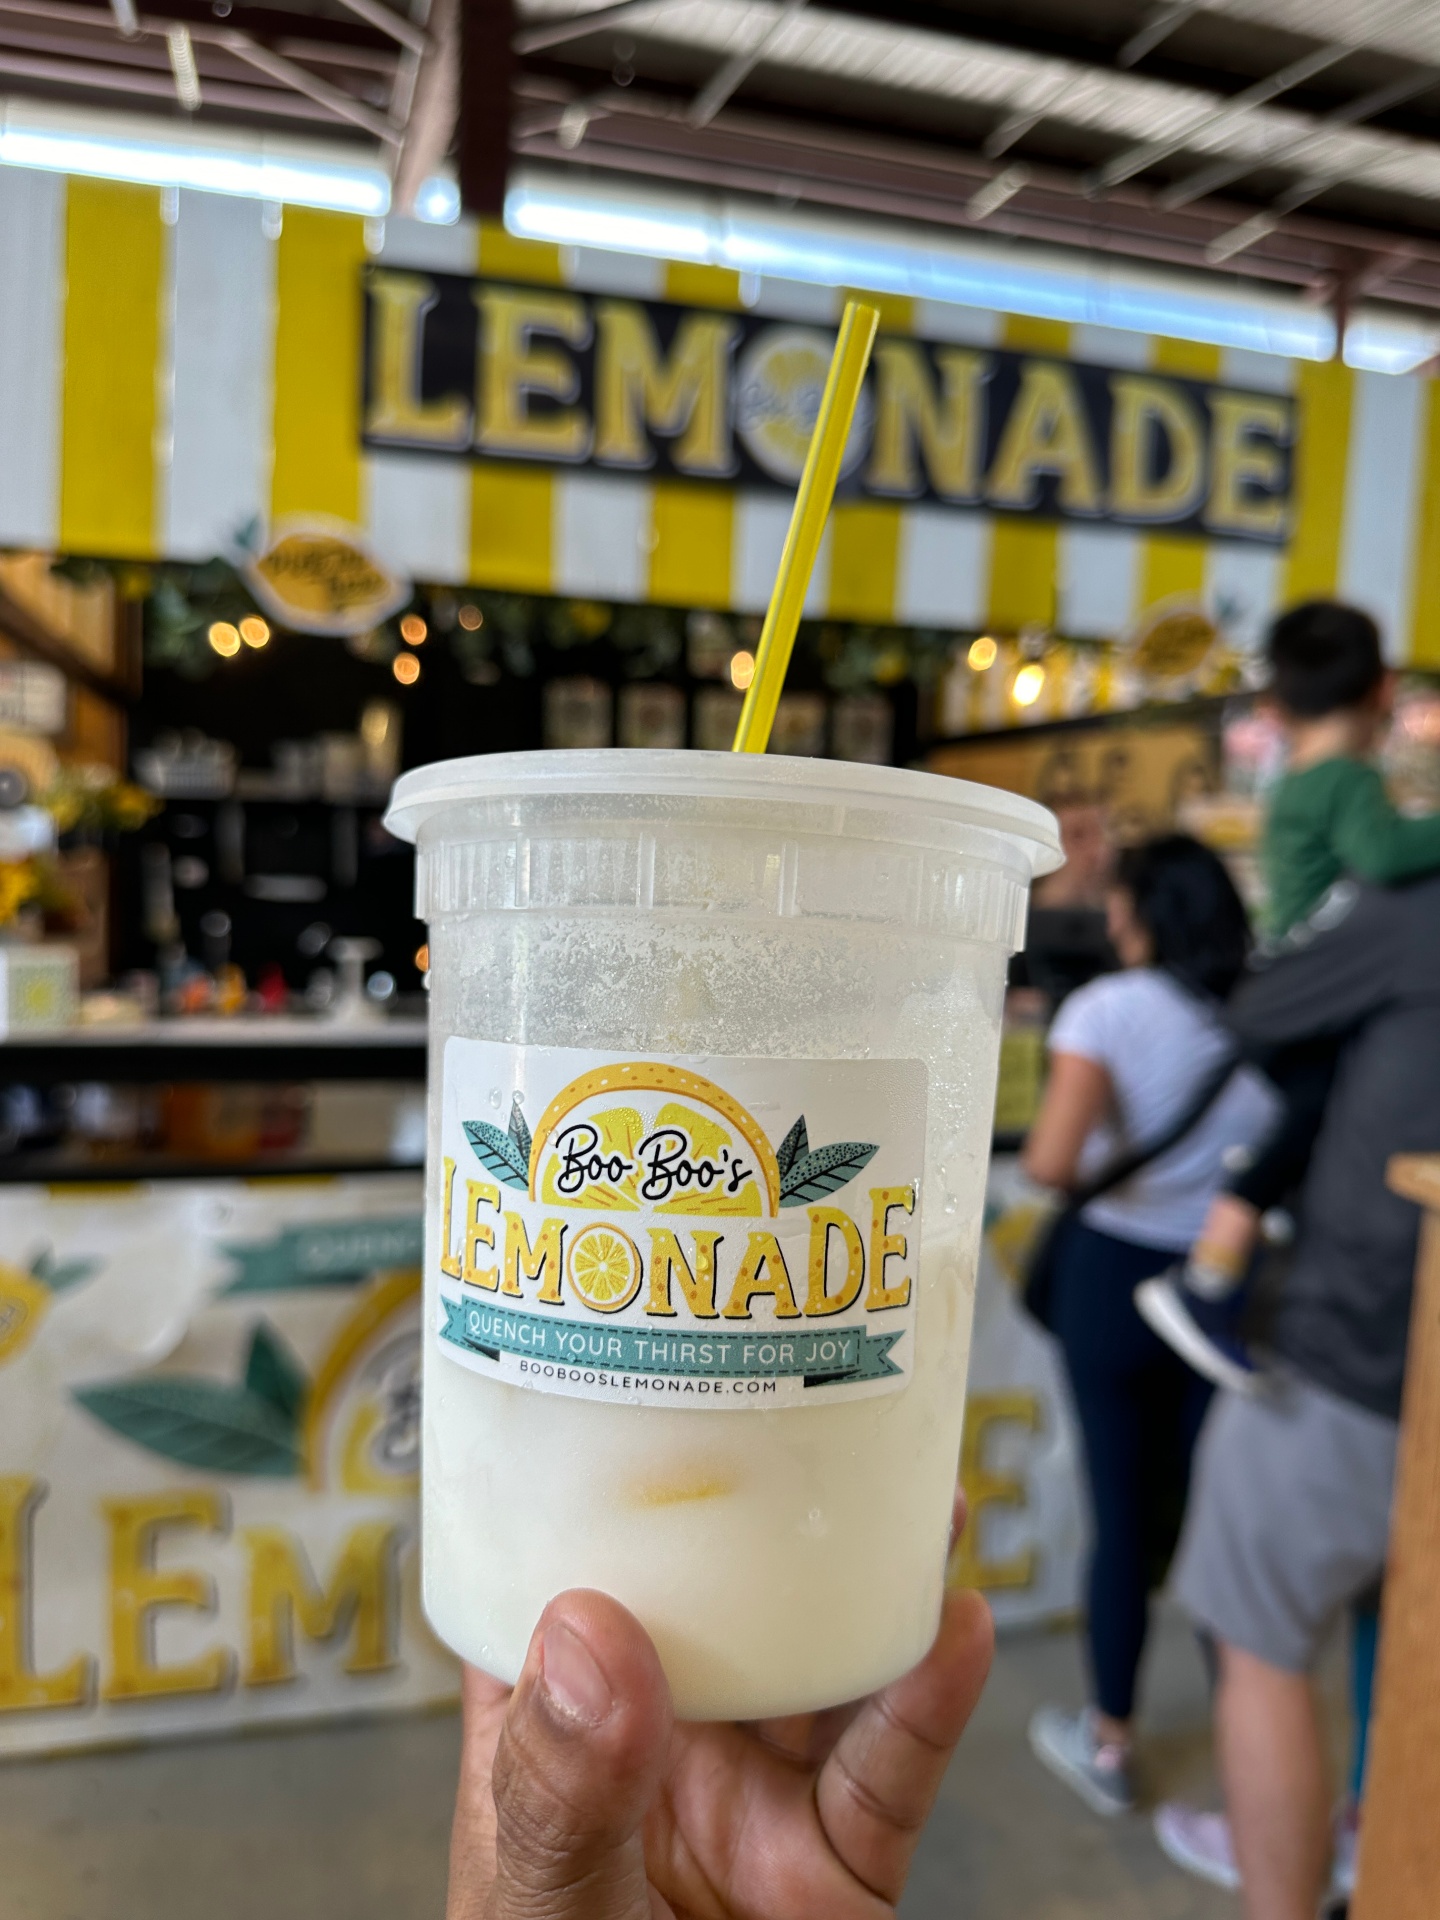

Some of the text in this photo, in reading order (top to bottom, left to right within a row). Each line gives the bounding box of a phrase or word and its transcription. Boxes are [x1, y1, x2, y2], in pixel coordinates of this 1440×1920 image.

[367, 270, 1296, 545] LEMONADE
[555, 1123, 753, 1200] Boo Boo's
[438, 1156, 916, 1320] LEMONADE
[468, 1309, 852, 1365] QUENCH YOUR THIRST FOR JOY
[519, 1359, 777, 1394] BOOBOOSLEMONADE.COM
